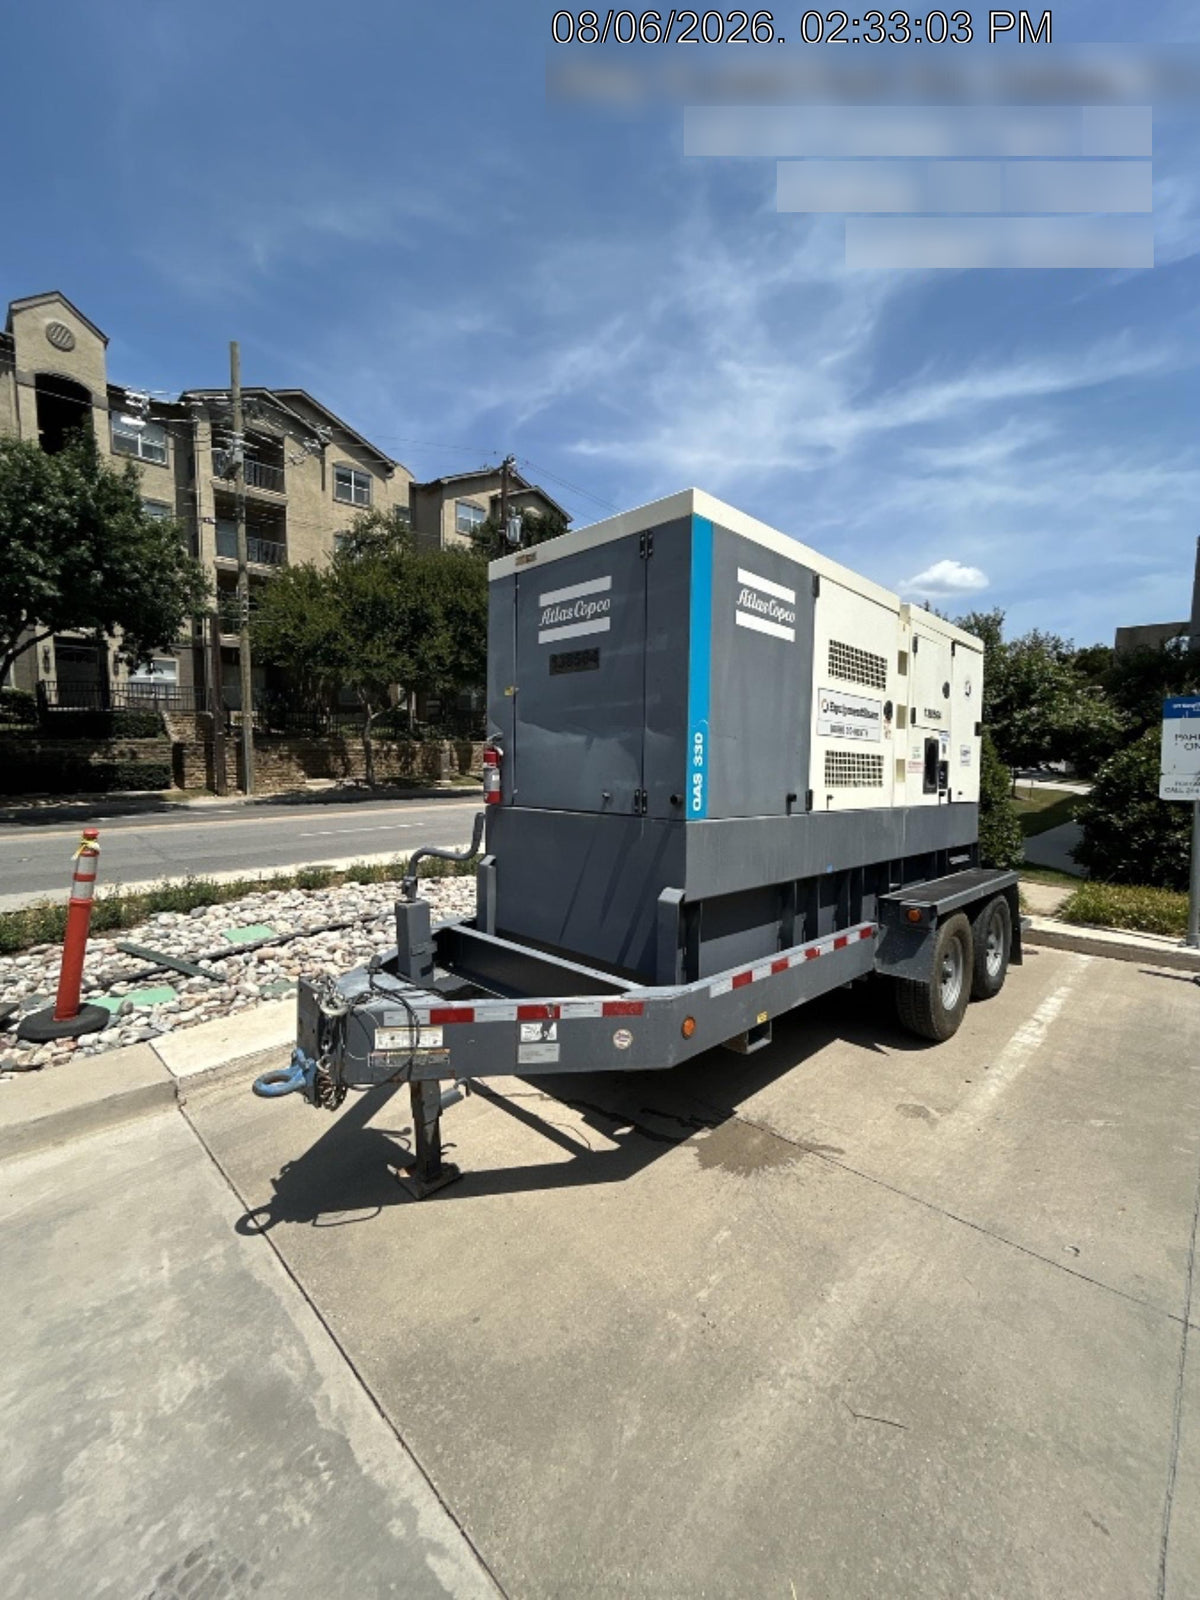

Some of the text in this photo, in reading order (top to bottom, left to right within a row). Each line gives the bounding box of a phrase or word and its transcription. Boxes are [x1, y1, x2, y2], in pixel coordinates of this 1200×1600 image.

[539, 599, 611, 627] Atlas Copco
[736, 588, 796, 623] Atlas Copco
